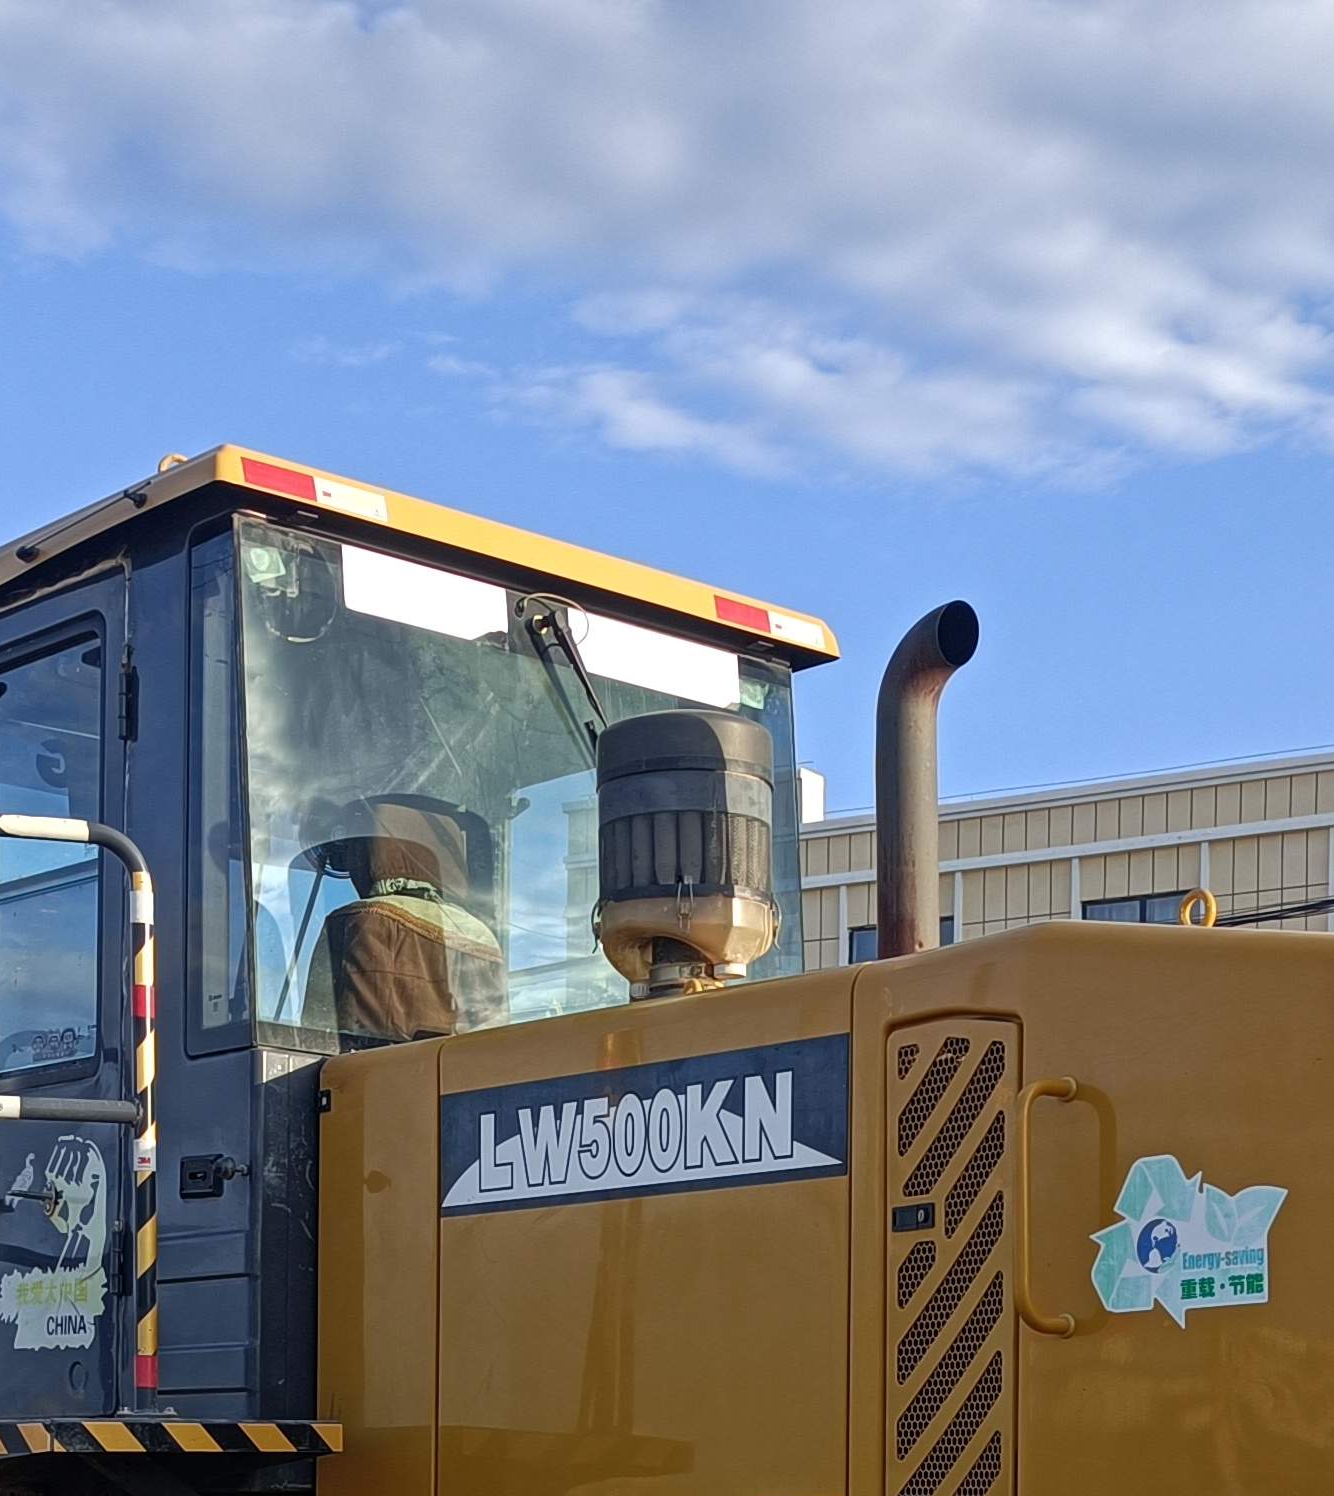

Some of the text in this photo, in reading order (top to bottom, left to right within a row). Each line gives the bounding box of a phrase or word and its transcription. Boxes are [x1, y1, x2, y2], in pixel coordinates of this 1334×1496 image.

[478, 1070, 794, 1194] LW500KN
[1182, 1246, 1264, 1270] Energy-saving
[46, 1315, 87, 1336] CHINA
